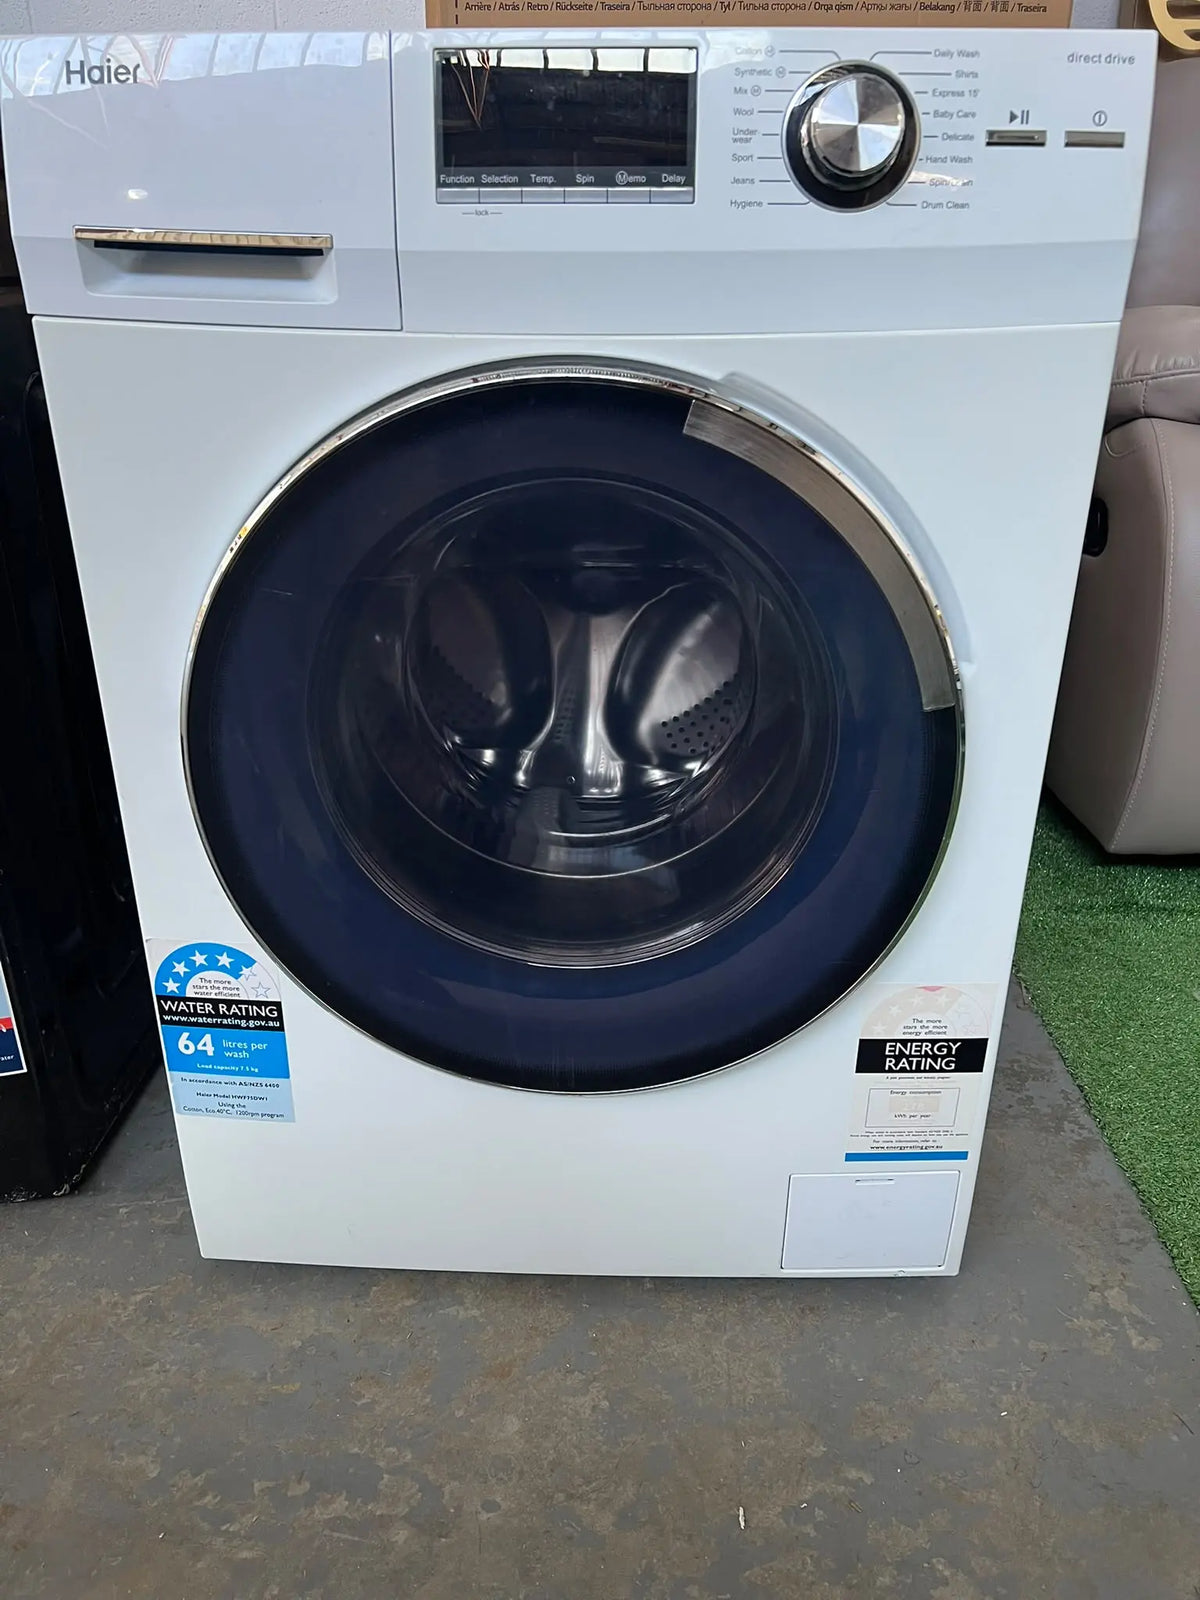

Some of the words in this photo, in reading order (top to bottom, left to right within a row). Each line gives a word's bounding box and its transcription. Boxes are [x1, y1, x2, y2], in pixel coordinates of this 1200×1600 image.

[464, 1, 492, 12] Arrière
[499, 1, 520, 12] Atrás
[527, 2, 549, 12] Retro
[555, 1, 593, 12] Rückseite
[600, 2, 631, 12] Traseira
[637, 1, 675, 12] Тыльная
[676, 3, 712, 13] сторона
[738, 1, 769, 12] Тильна
[770, 3, 807, 13] сторона
[813, 2, 834, 13] Orqa
[835, 2, 854, 13] qism
[919, 2, 956, 14] Belakang
[1017, 3, 1047, 13] Traseira
[934, 49, 955, 60] Daily
[956, 49, 980, 58] Wash
[1067, 52, 1102, 64] direct
[1104, 53, 1136, 65] drive
[65, 57, 141, 85] Haier
[734, 67, 773, 78] Synthetic
[955, 70, 979, 79] Shirts
[733, 86, 748, 95] Mix
[932, 88, 965, 99] Express
[733, 107, 754, 116] Wool
[933, 109, 955, 120] Baby
[956, 110, 977, 119] Care
[732, 136, 753, 144] wear
[941, 132, 974, 141] Delicate
[731, 153, 754, 163] Sport
[925, 155, 948, 164] Hand
[949, 155, 973, 164] Wash
[440, 174, 475, 184] Function
[481, 174, 519, 184] Selection
[530, 174, 557, 185] Temp.
[575, 174, 595, 185] Spin
[661, 174, 686, 185] Delay
[730, 176, 756, 185] Jeans
[730, 199, 763, 210] Hygiene
[921, 200, 945, 209] Drum
[945, 200, 970, 209] Clean
[474, 208, 489, 217] lock
[199, 977, 212, 985] The
[214, 990, 241, 998] efficient
[160, 999, 216, 1015] WATER
[218, 1003, 279, 1018] RATING
[162, 1014, 280, 1028] www.waterrating.gov.au
[177, 1031, 215, 1056] 64
[222, 1039, 248, 1050] litres
[250, 1042, 268, 1052] per
[885, 1041, 962, 1056] ENERGY
[224, 1050, 250, 1059] wash
[213, 1064, 239, 1072] capacity
[884, 1057, 957, 1071] RATING
[218, 1101, 235, 1109] Using
[235, 1110, 260, 1118] 1200rpm
[260, 1111, 284, 1119] program
